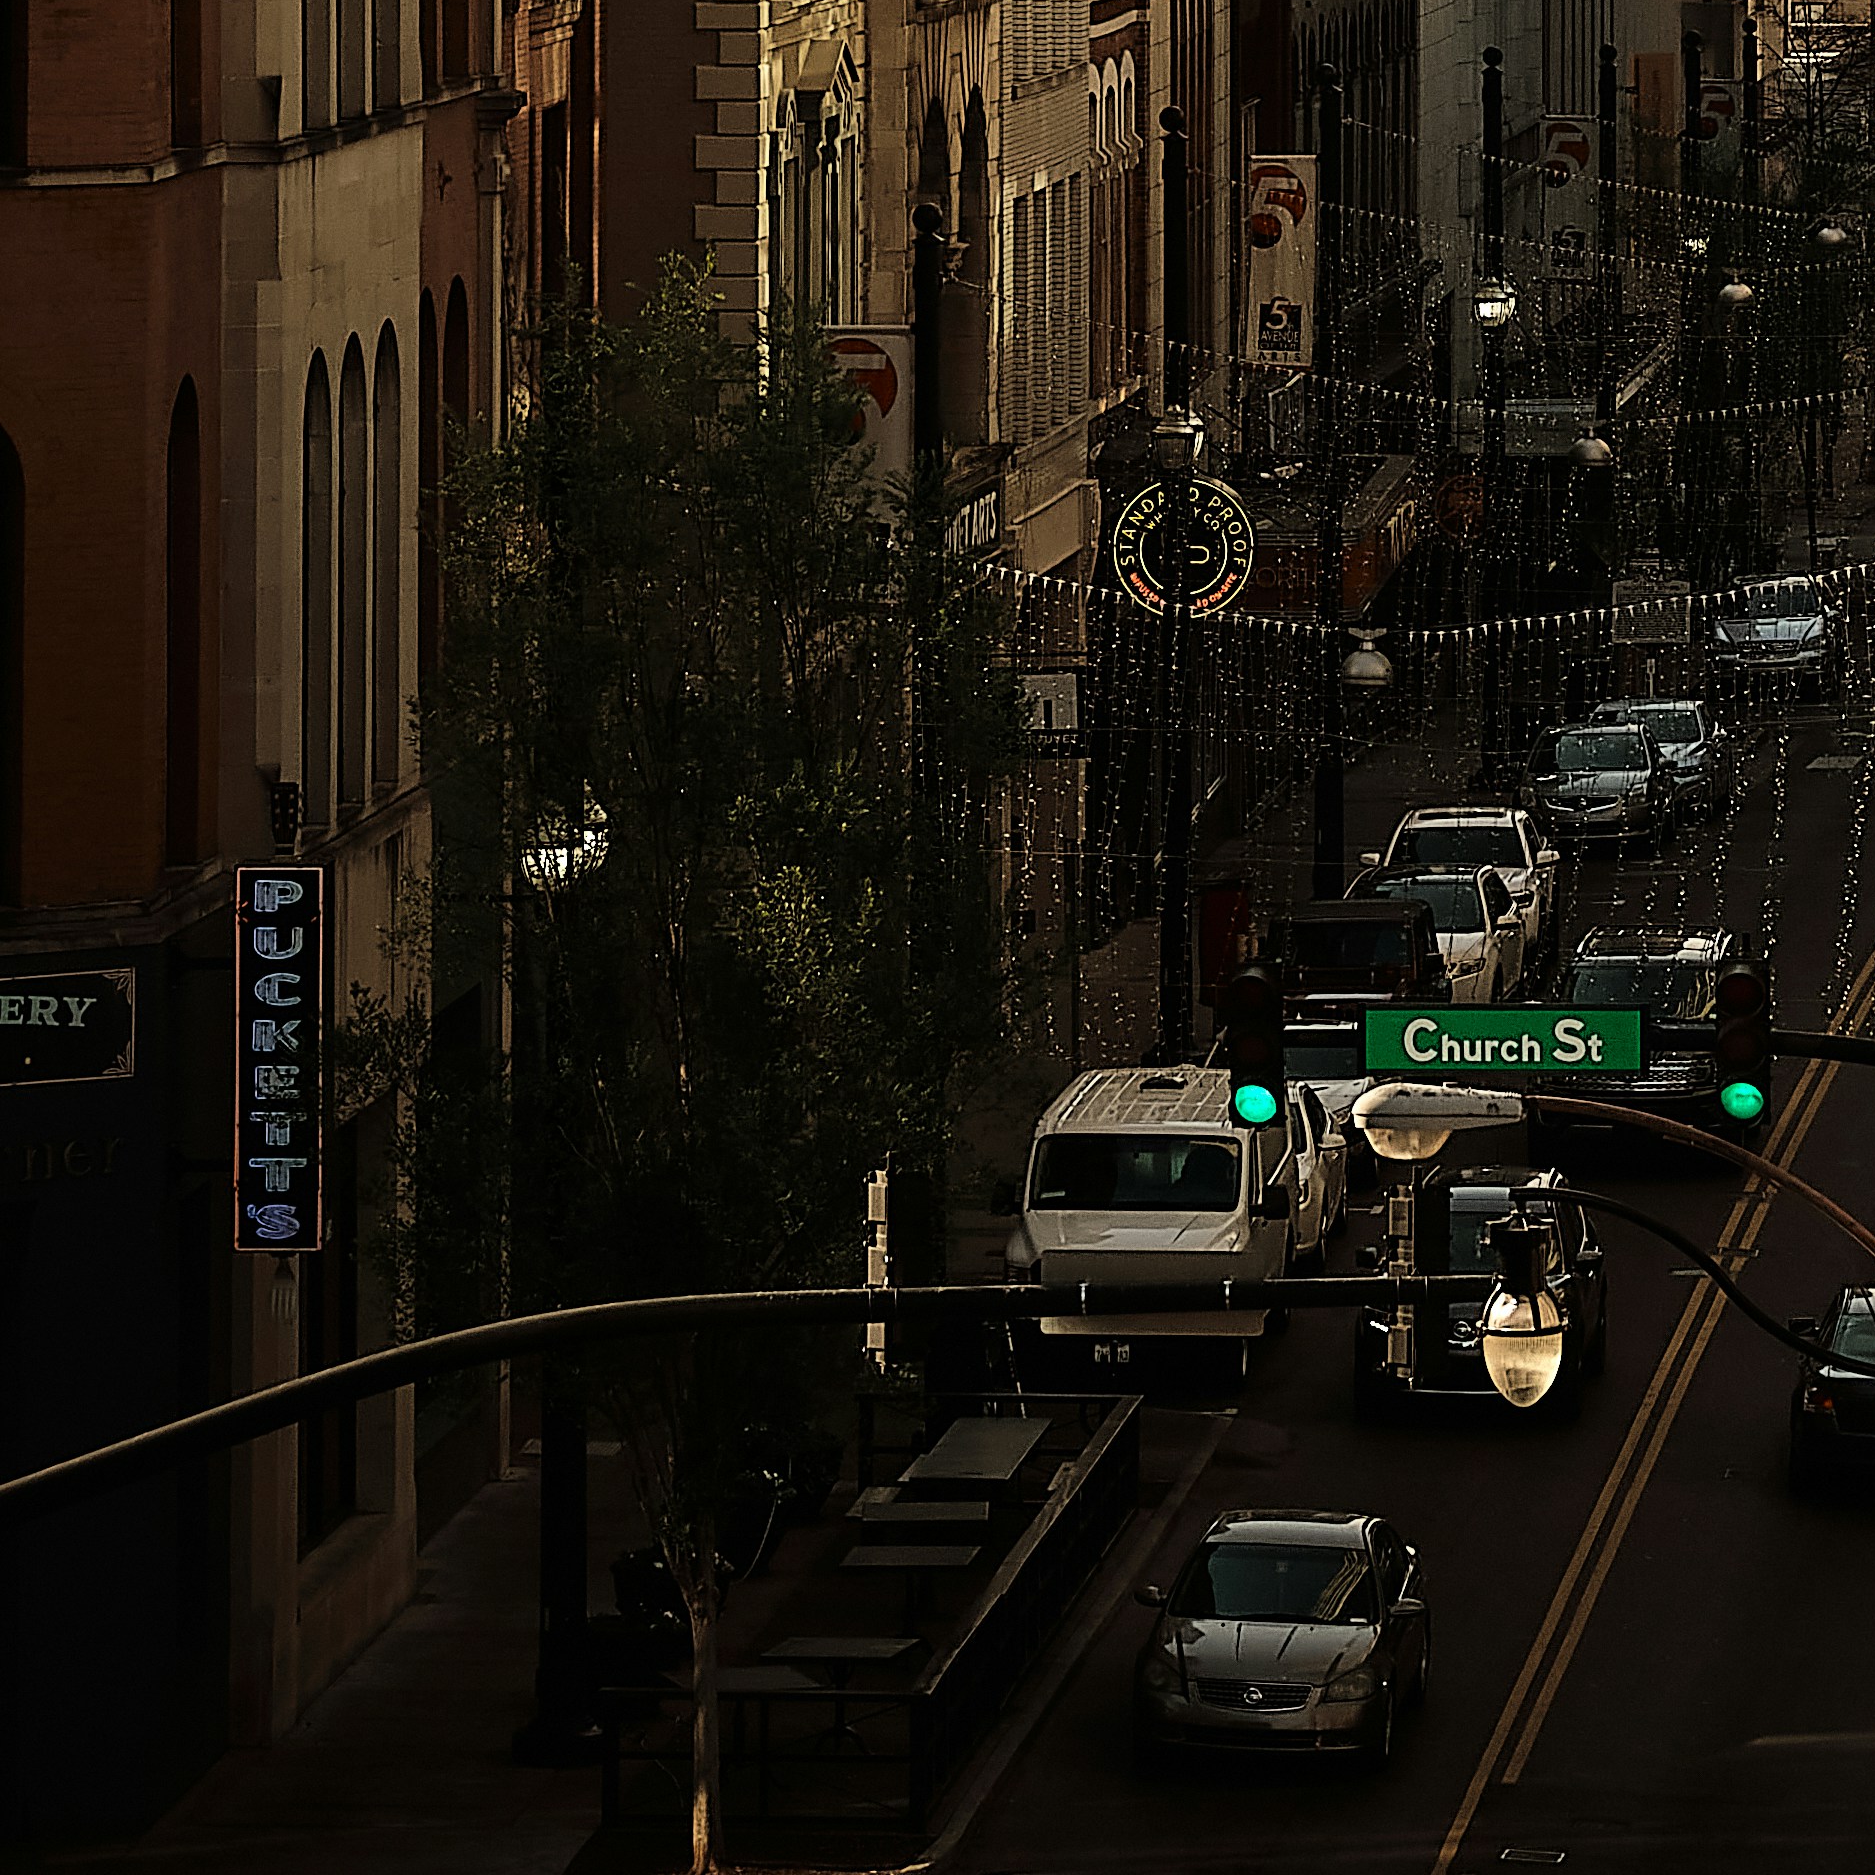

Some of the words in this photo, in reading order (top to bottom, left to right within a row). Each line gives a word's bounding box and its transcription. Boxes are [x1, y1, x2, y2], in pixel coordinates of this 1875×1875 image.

[1260, 330, 1299, 342] AVENUE
[1257, 351, 1301, 362] ARTS
[971, 490, 997, 546] ARTS
[0, 995, 98, 1028] ERY
[1403, 1017, 1541, 1063] Church
[1552, 1017, 1604, 1063] St
[246, 879, 308, 1241] PUCKETT'S
